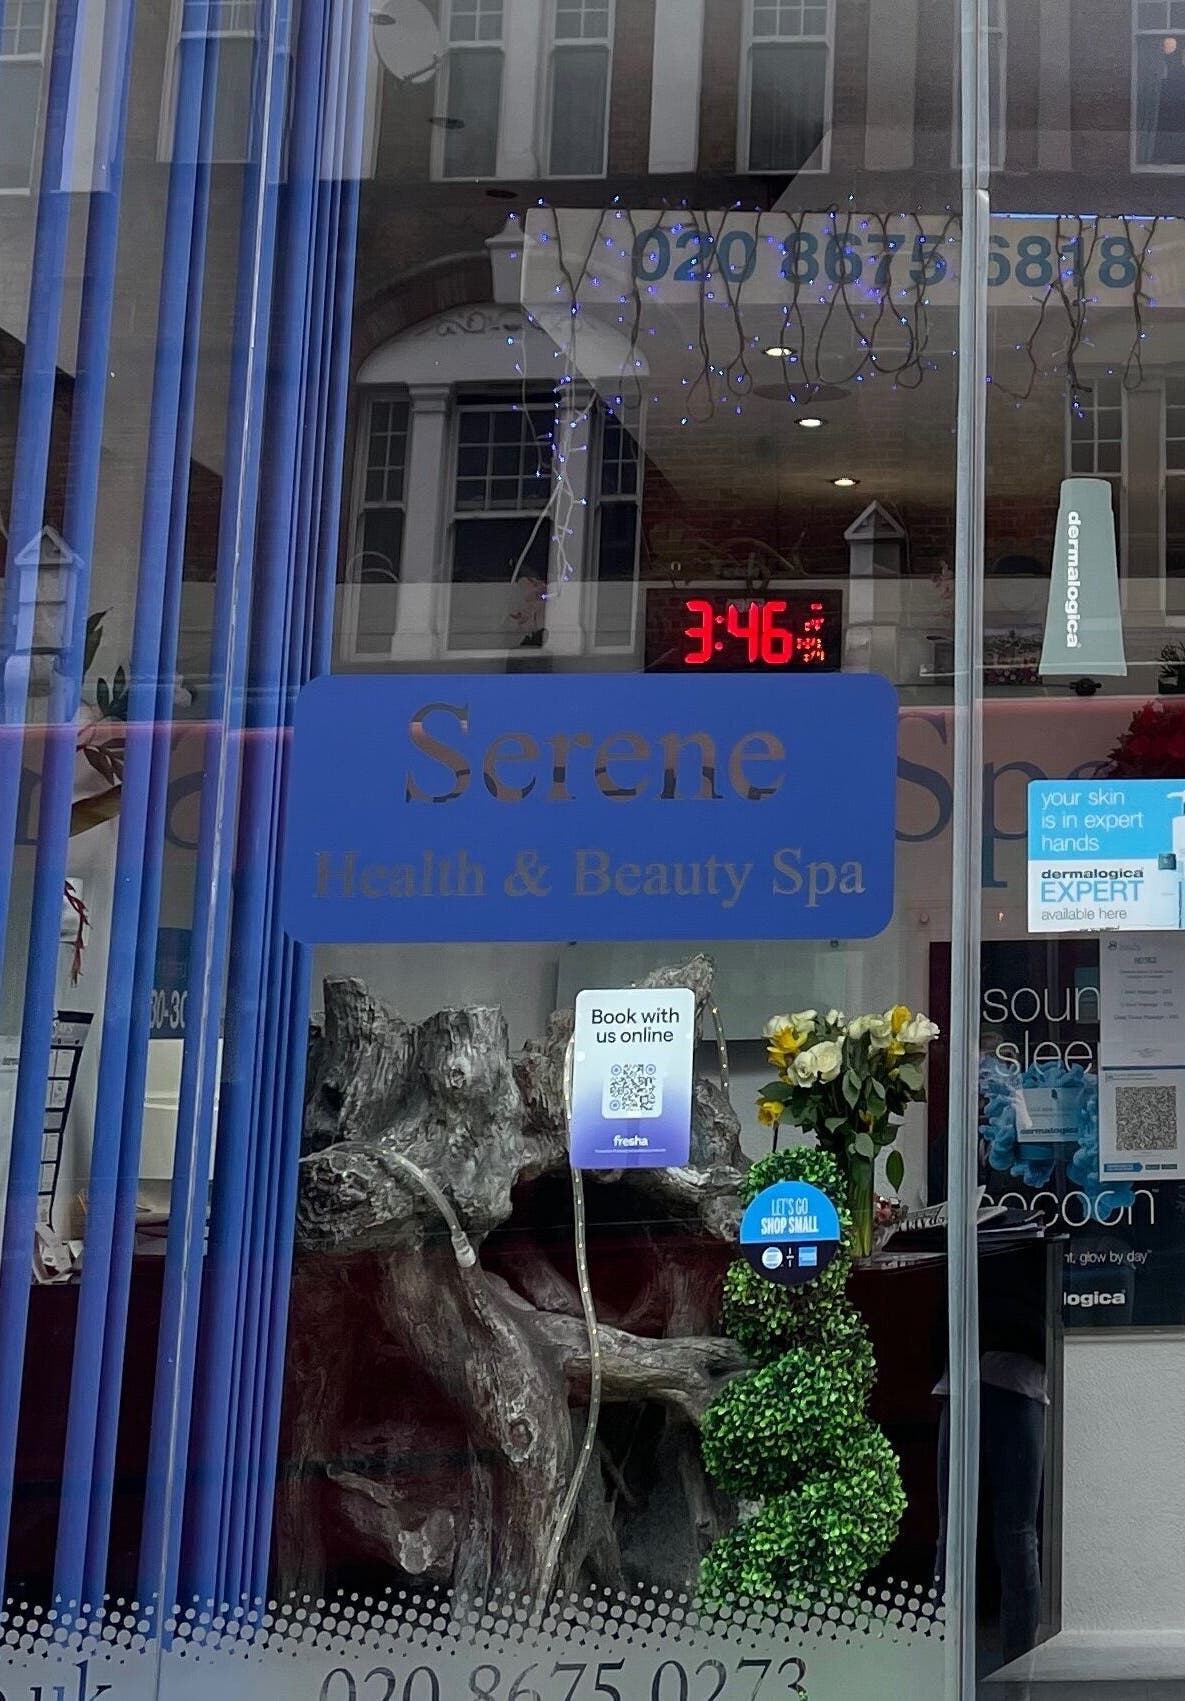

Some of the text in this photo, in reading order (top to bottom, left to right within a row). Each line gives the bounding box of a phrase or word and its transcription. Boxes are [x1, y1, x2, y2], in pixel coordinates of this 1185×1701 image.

[634, 230, 1138, 288] 020 8675 6818
[1066, 511, 1081, 647] dermalogica
[685, 601, 793, 663] 3:46
[404, 701, 787, 803] Serene
[1041, 789, 1125, 810] your skin
[1041, 812, 1144, 832] is in expert
[1041, 835, 1100, 852] hands
[312, 848, 866, 909] Health & Beauty Spa
[1041, 868, 1144, 880] dermalogica
[1041, 879, 1144, 903] EXPERT
[1041, 906, 1128, 921] available here
[982, 986, 1100, 1023] soun
[591, 1007, 680, 1024] Book with
[596, 1026, 674, 1043] us online
[995, 1029, 1100, 1078] slee
[613, 1134, 649, 1147] fresha
[771, 1197, 809, 1217] LET'S GO
[760, 1215, 819, 1236] SHOP SMALL
[1079, 1251, 1105, 1265] glow
[1109, 1250, 1124, 1266] by
[1126, 1250, 1148, 1266] day
[321, 1657, 808, 1701] 020 8675 0273
